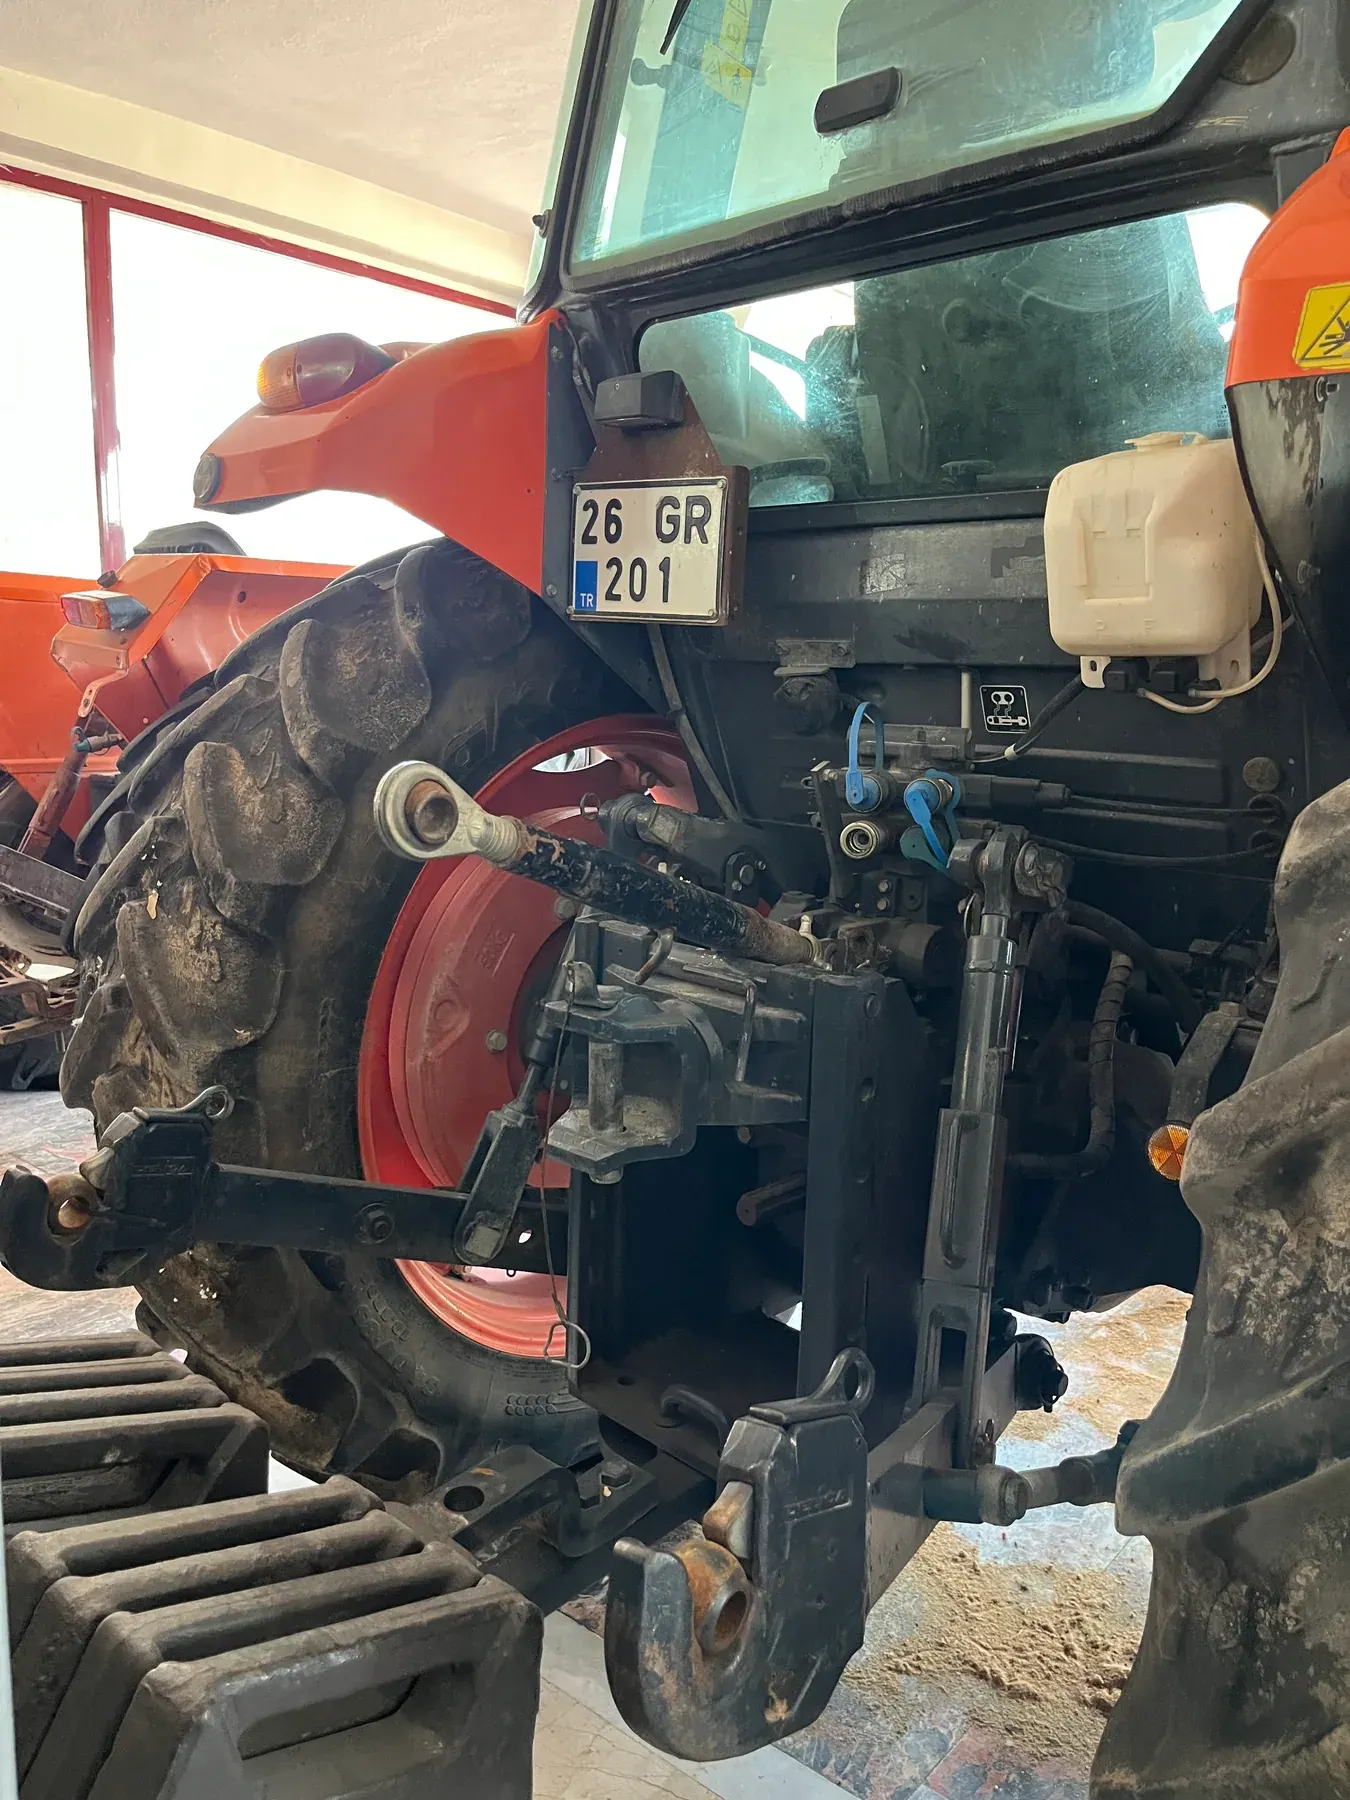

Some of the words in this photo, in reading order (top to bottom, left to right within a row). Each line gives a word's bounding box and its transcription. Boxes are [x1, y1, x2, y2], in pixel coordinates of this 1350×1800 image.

[581, 498, 622, 544] 26
[655, 495, 712, 544] GR
[580, 593, 594, 608] TR
[604, 557, 671, 602] 201
